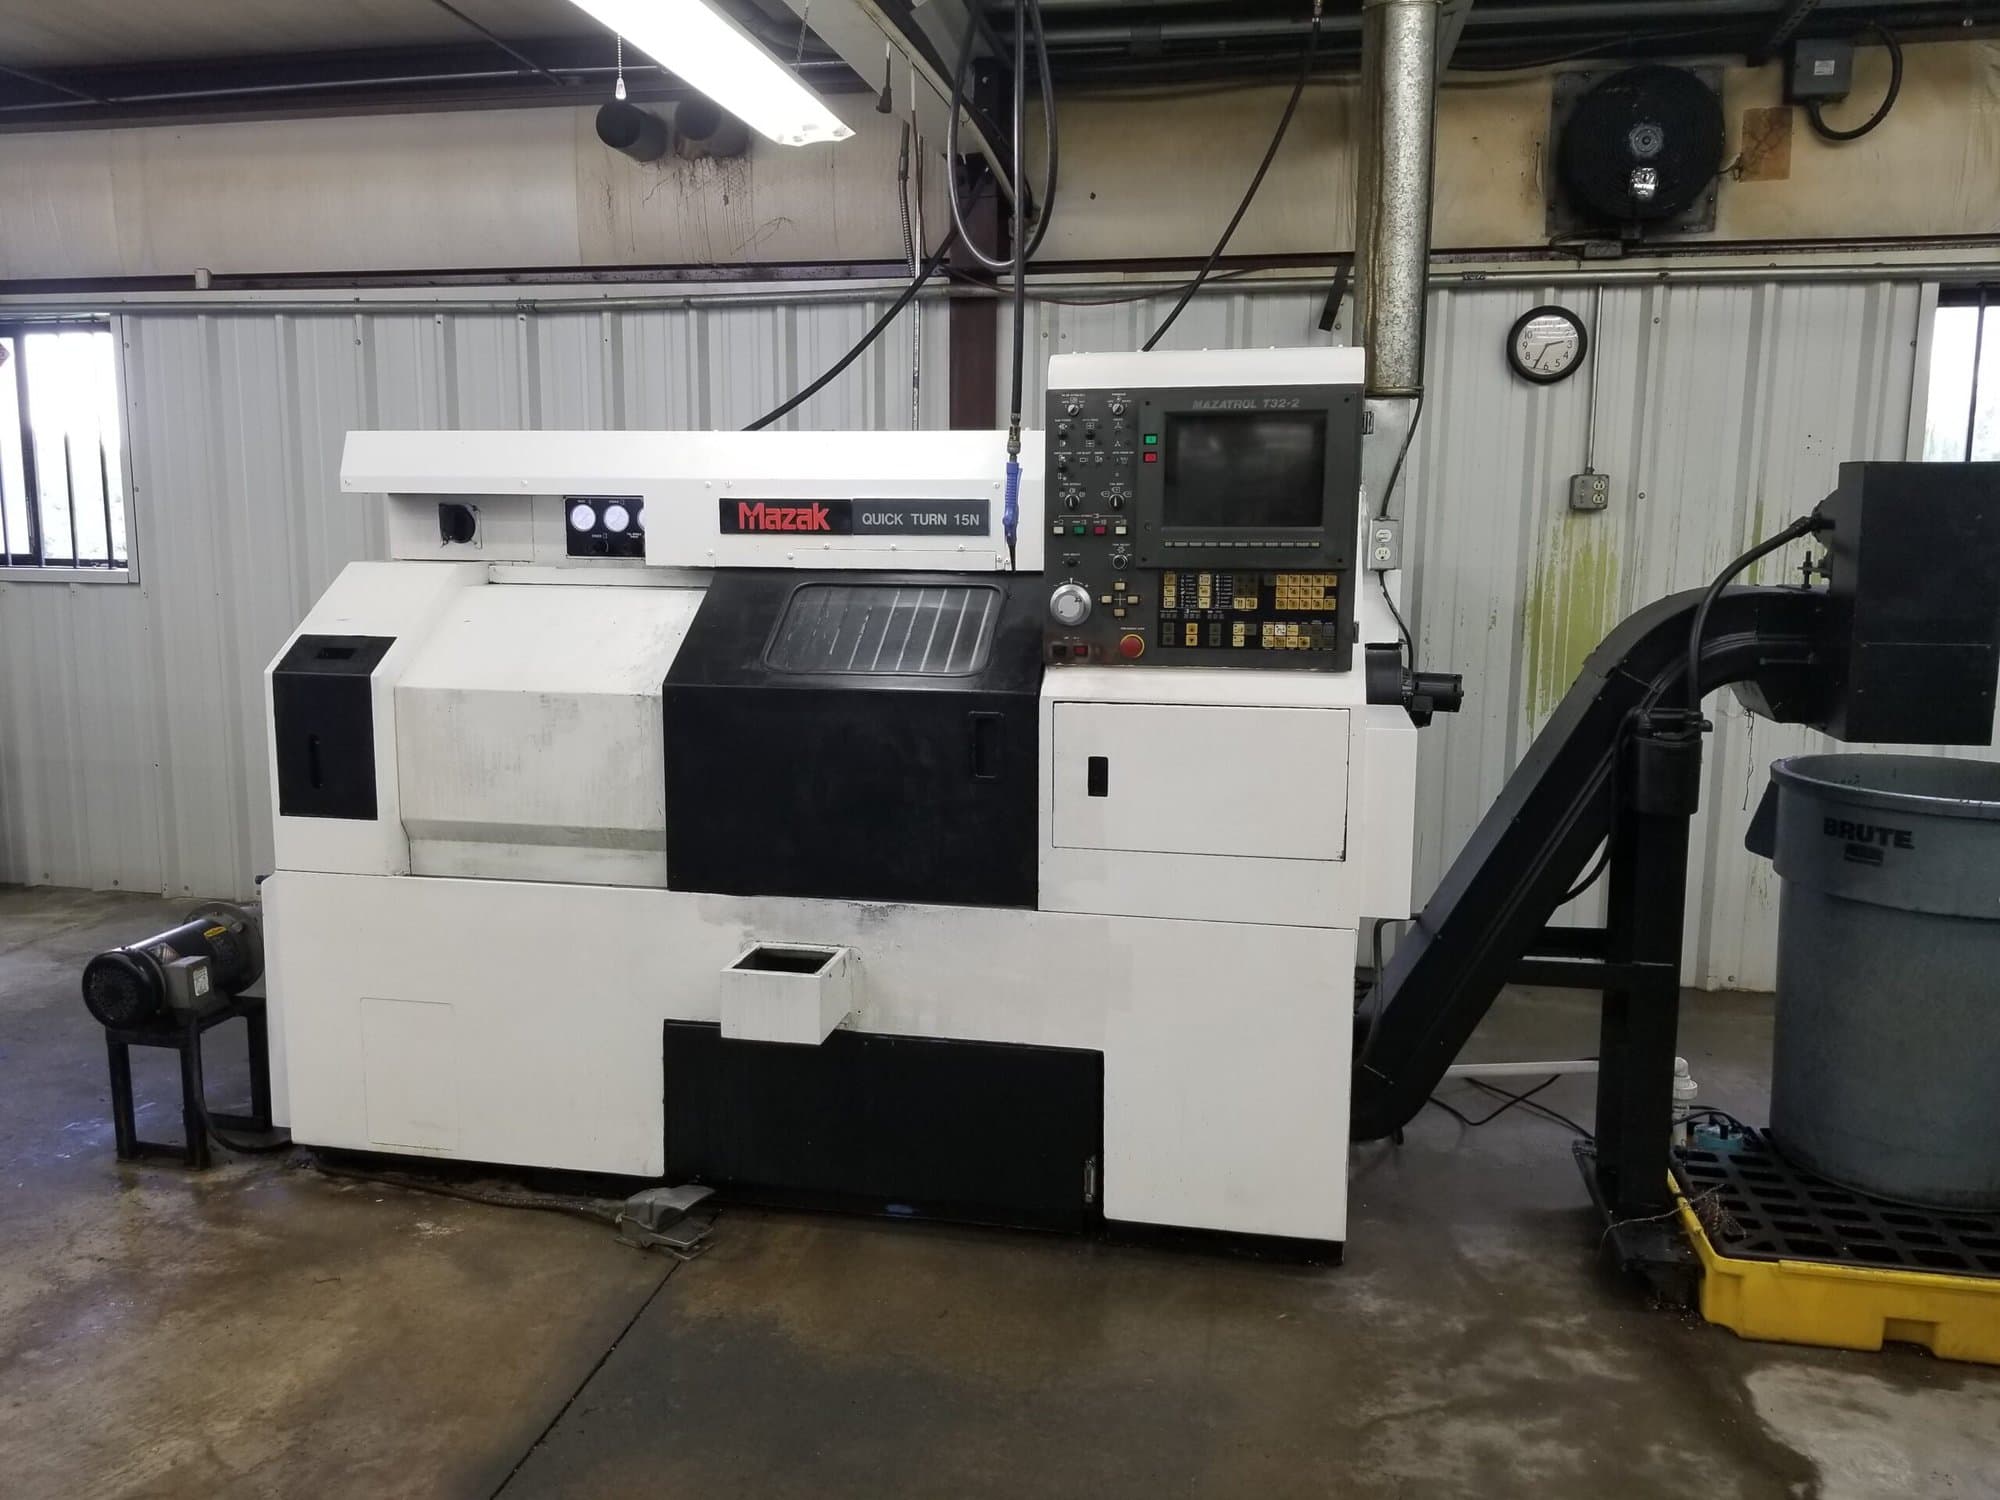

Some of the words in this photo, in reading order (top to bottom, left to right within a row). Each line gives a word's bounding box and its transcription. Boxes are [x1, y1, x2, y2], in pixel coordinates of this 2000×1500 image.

[1525, 329, 1532, 339] 10
[1522, 341, 1528, 349] 9
[1567, 340, 1572, 349] 3
[1525, 351, 1530, 360] 8
[1563, 350, 1568, 359] 4
[1543, 361, 1549, 370] 6
[1555, 358, 1560, 367] 5
[1192, 399, 1257, 409] MAZATROL
[738, 502, 832, 532] Mazak
[861, 512, 904, 526] QUICK
[911, 513, 947, 526] TURN
[953, 513, 980, 527] 15N
[1823, 816, 1915, 850] BRUTE
